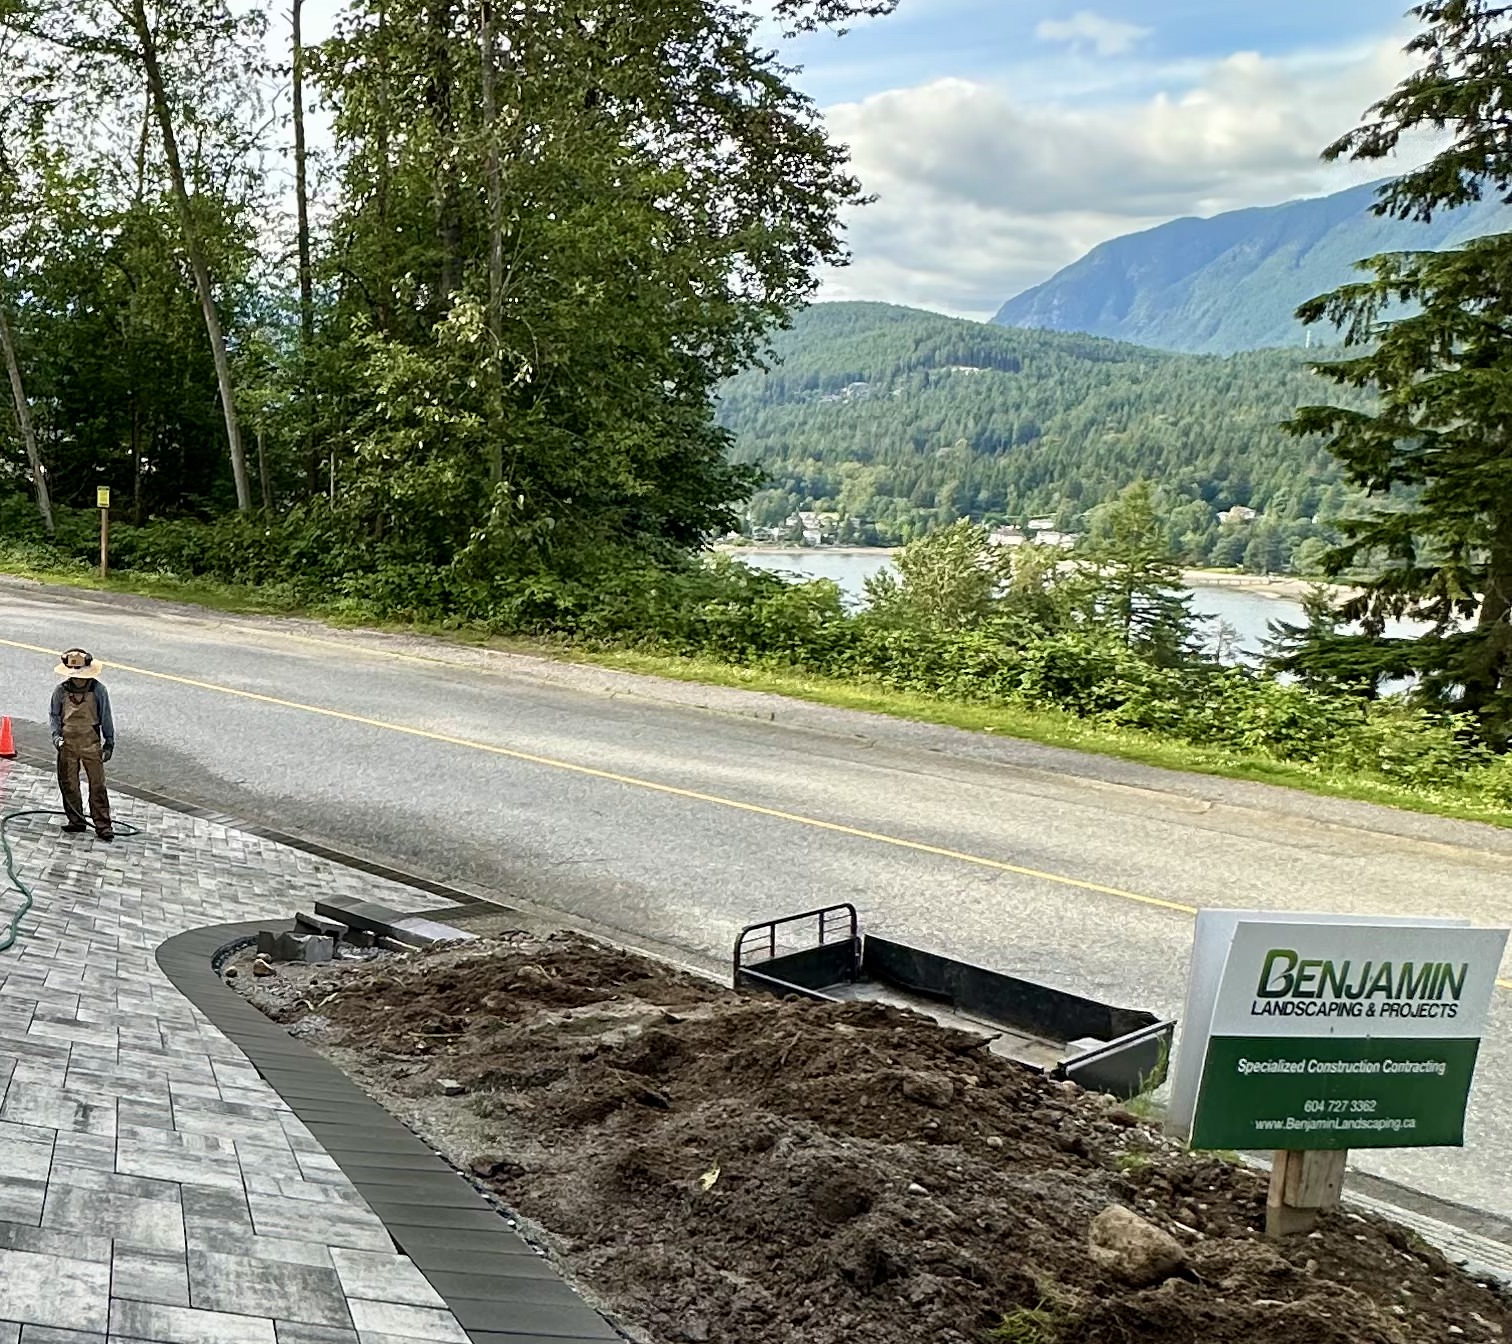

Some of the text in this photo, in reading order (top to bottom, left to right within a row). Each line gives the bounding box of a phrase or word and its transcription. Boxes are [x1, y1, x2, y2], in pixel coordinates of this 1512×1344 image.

[1257, 949, 1468, 1000] BENJAMIN
[1251, 1000, 1458, 1018] LANDSCAPING & PROJECTS
[1238, 1059, 1446, 1075] Specialized Construction Contracting
[1304, 1100, 1377, 1112] 604 727 3362
[1255, 1117, 1416, 1132] www.BenjaminLandscaping.ca
